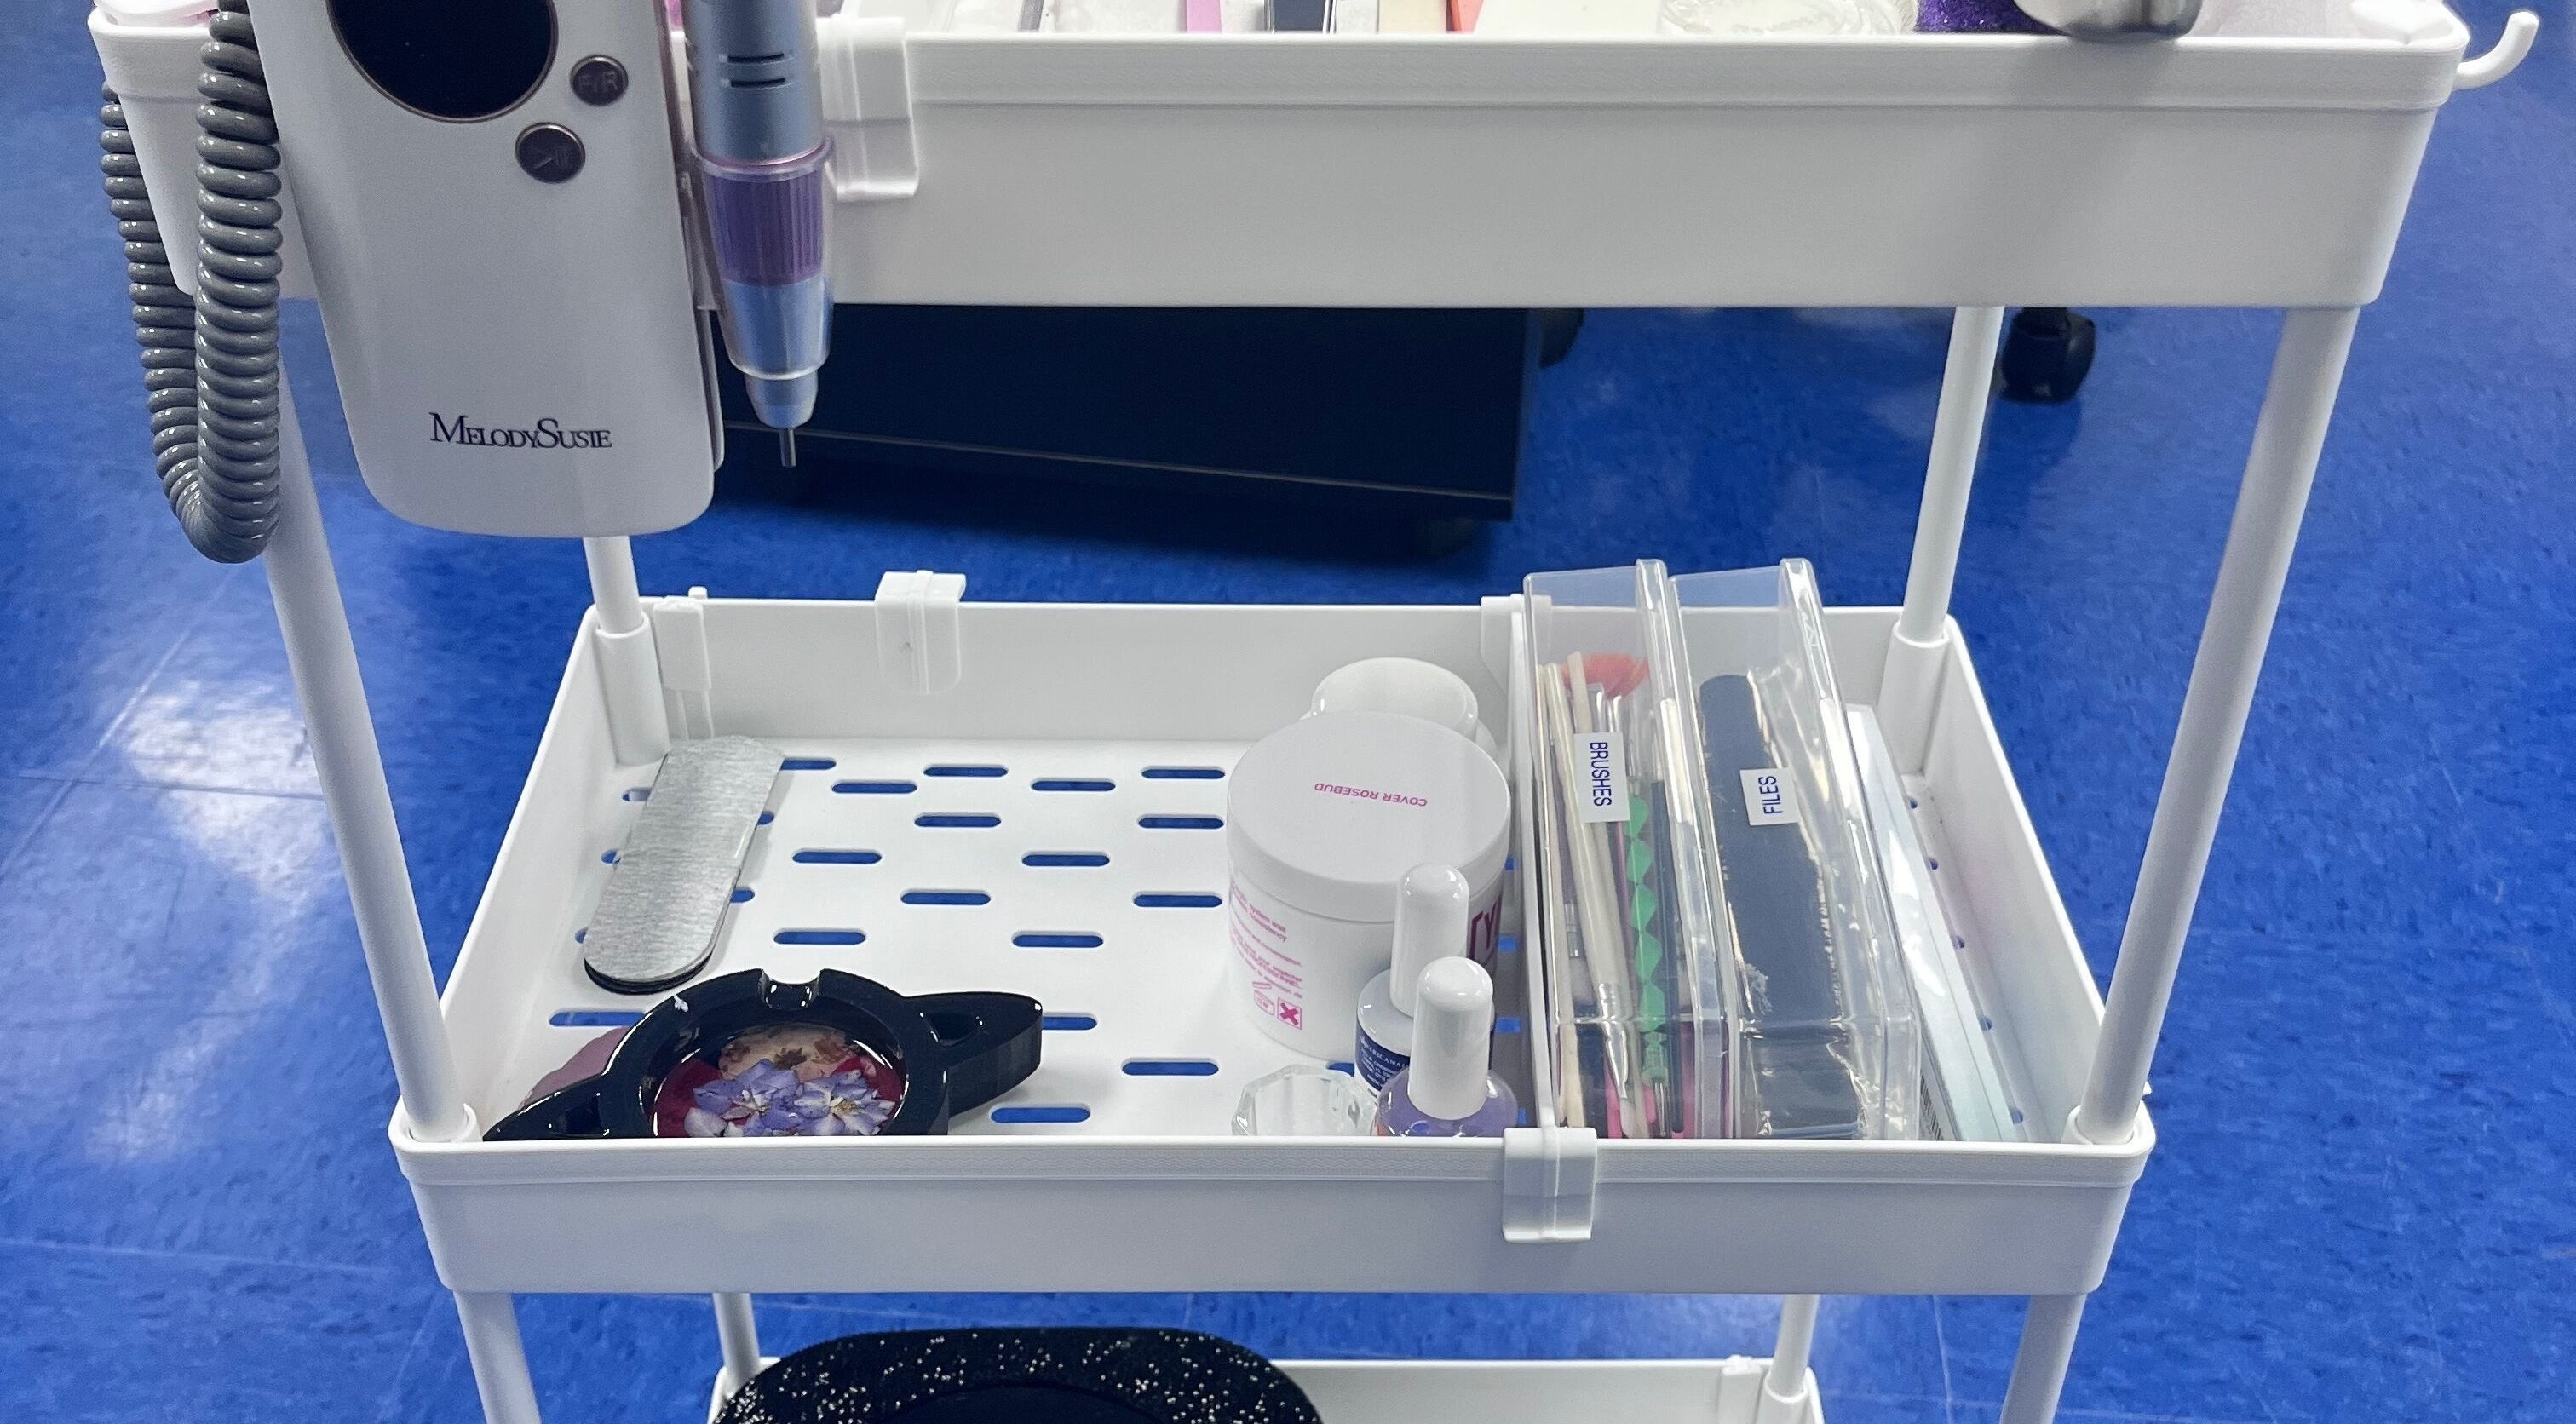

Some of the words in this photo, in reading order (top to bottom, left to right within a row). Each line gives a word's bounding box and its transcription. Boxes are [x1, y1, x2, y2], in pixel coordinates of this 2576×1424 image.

[1590, 741, 1613, 807] BRUSHES
[1314, 783, 1379, 800] ROSEBUD
[1382, 792, 1428, 807] COVER
[1757, 775, 1784, 814] FILES
